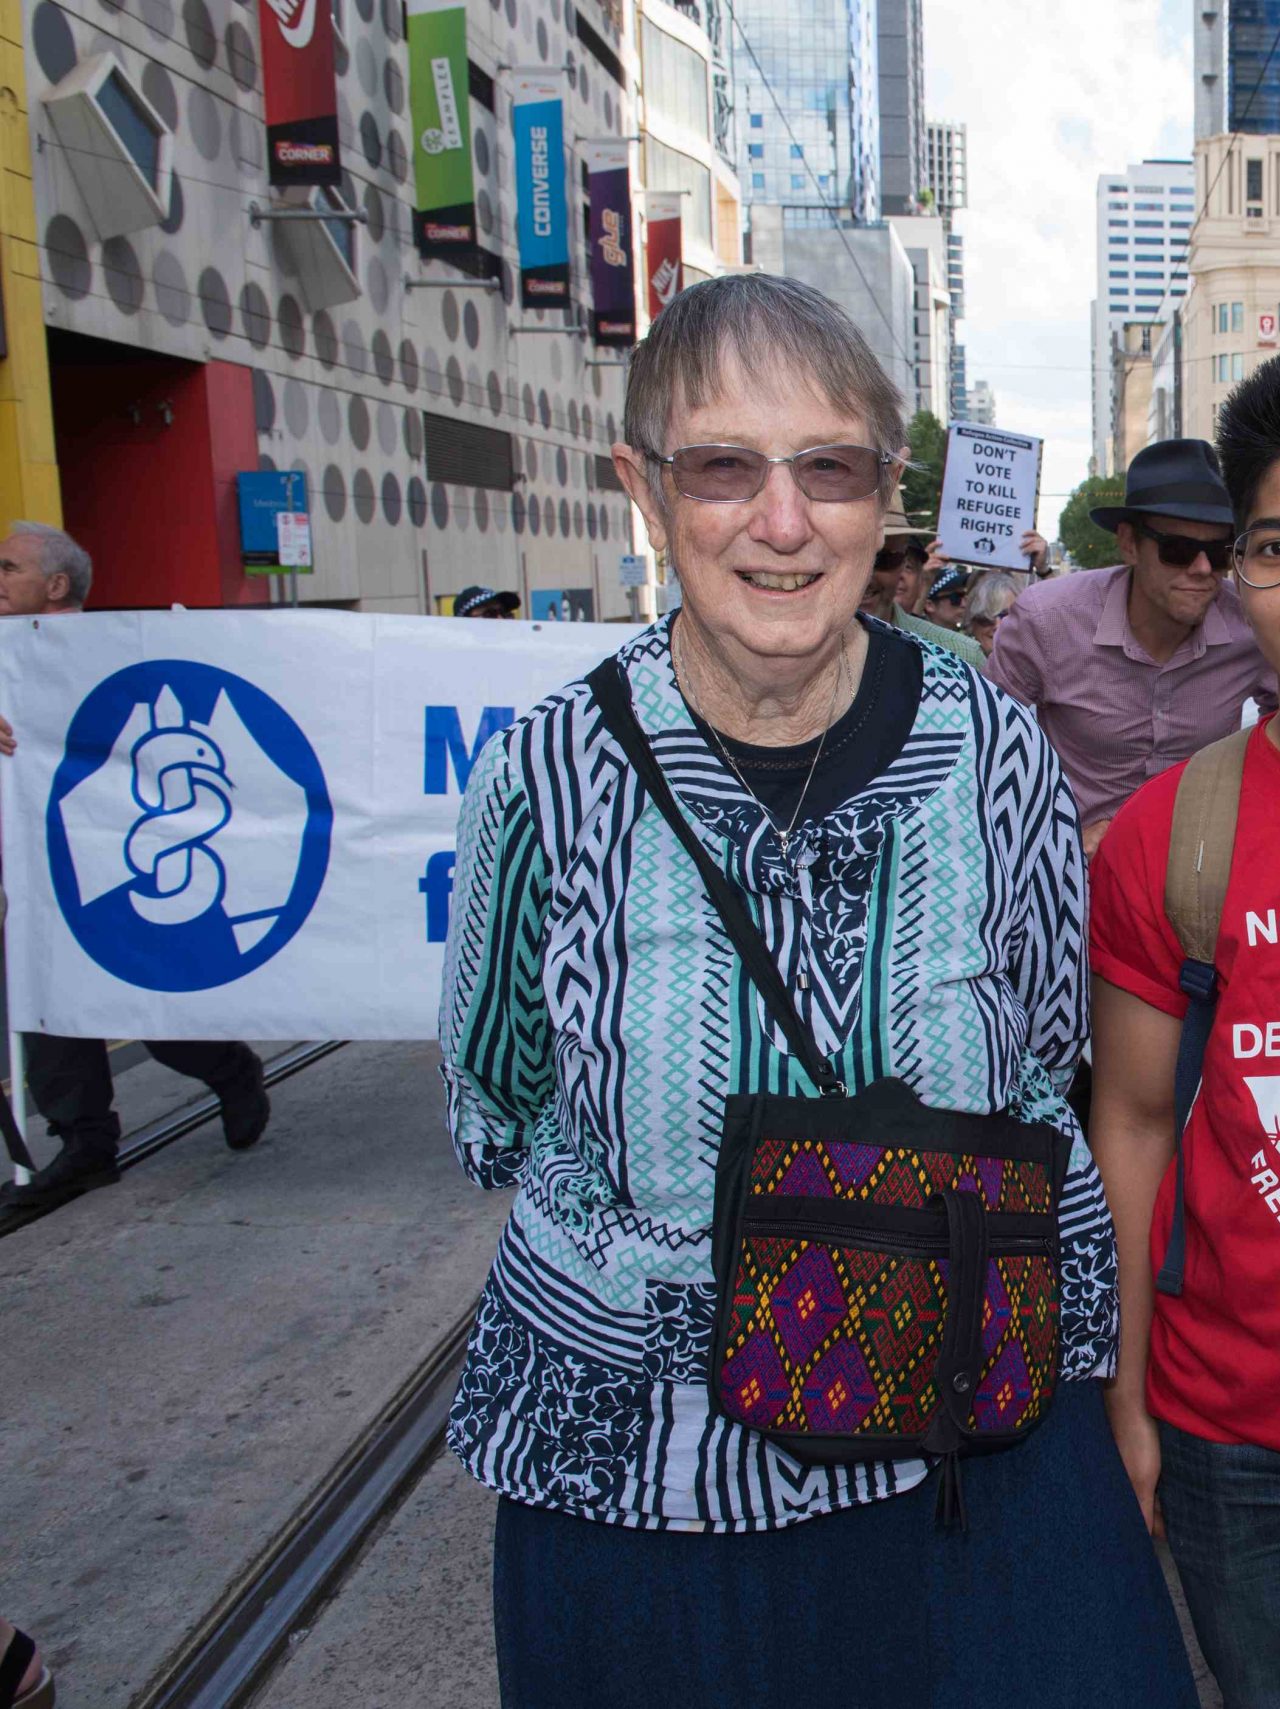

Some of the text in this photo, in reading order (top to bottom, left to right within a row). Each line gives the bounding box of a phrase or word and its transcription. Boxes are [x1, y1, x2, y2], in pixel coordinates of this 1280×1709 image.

[279, 147, 331, 161] CORNER
[530, 126, 552, 237] CONVERSE
[973, 443, 1017, 462] DON'T
[975, 462, 1012, 480] VOTE
[965, 480, 1017, 500] TO KILL
[956, 497, 1021, 519] REFUGEE
[960, 517, 1014, 537] RIGHTS
